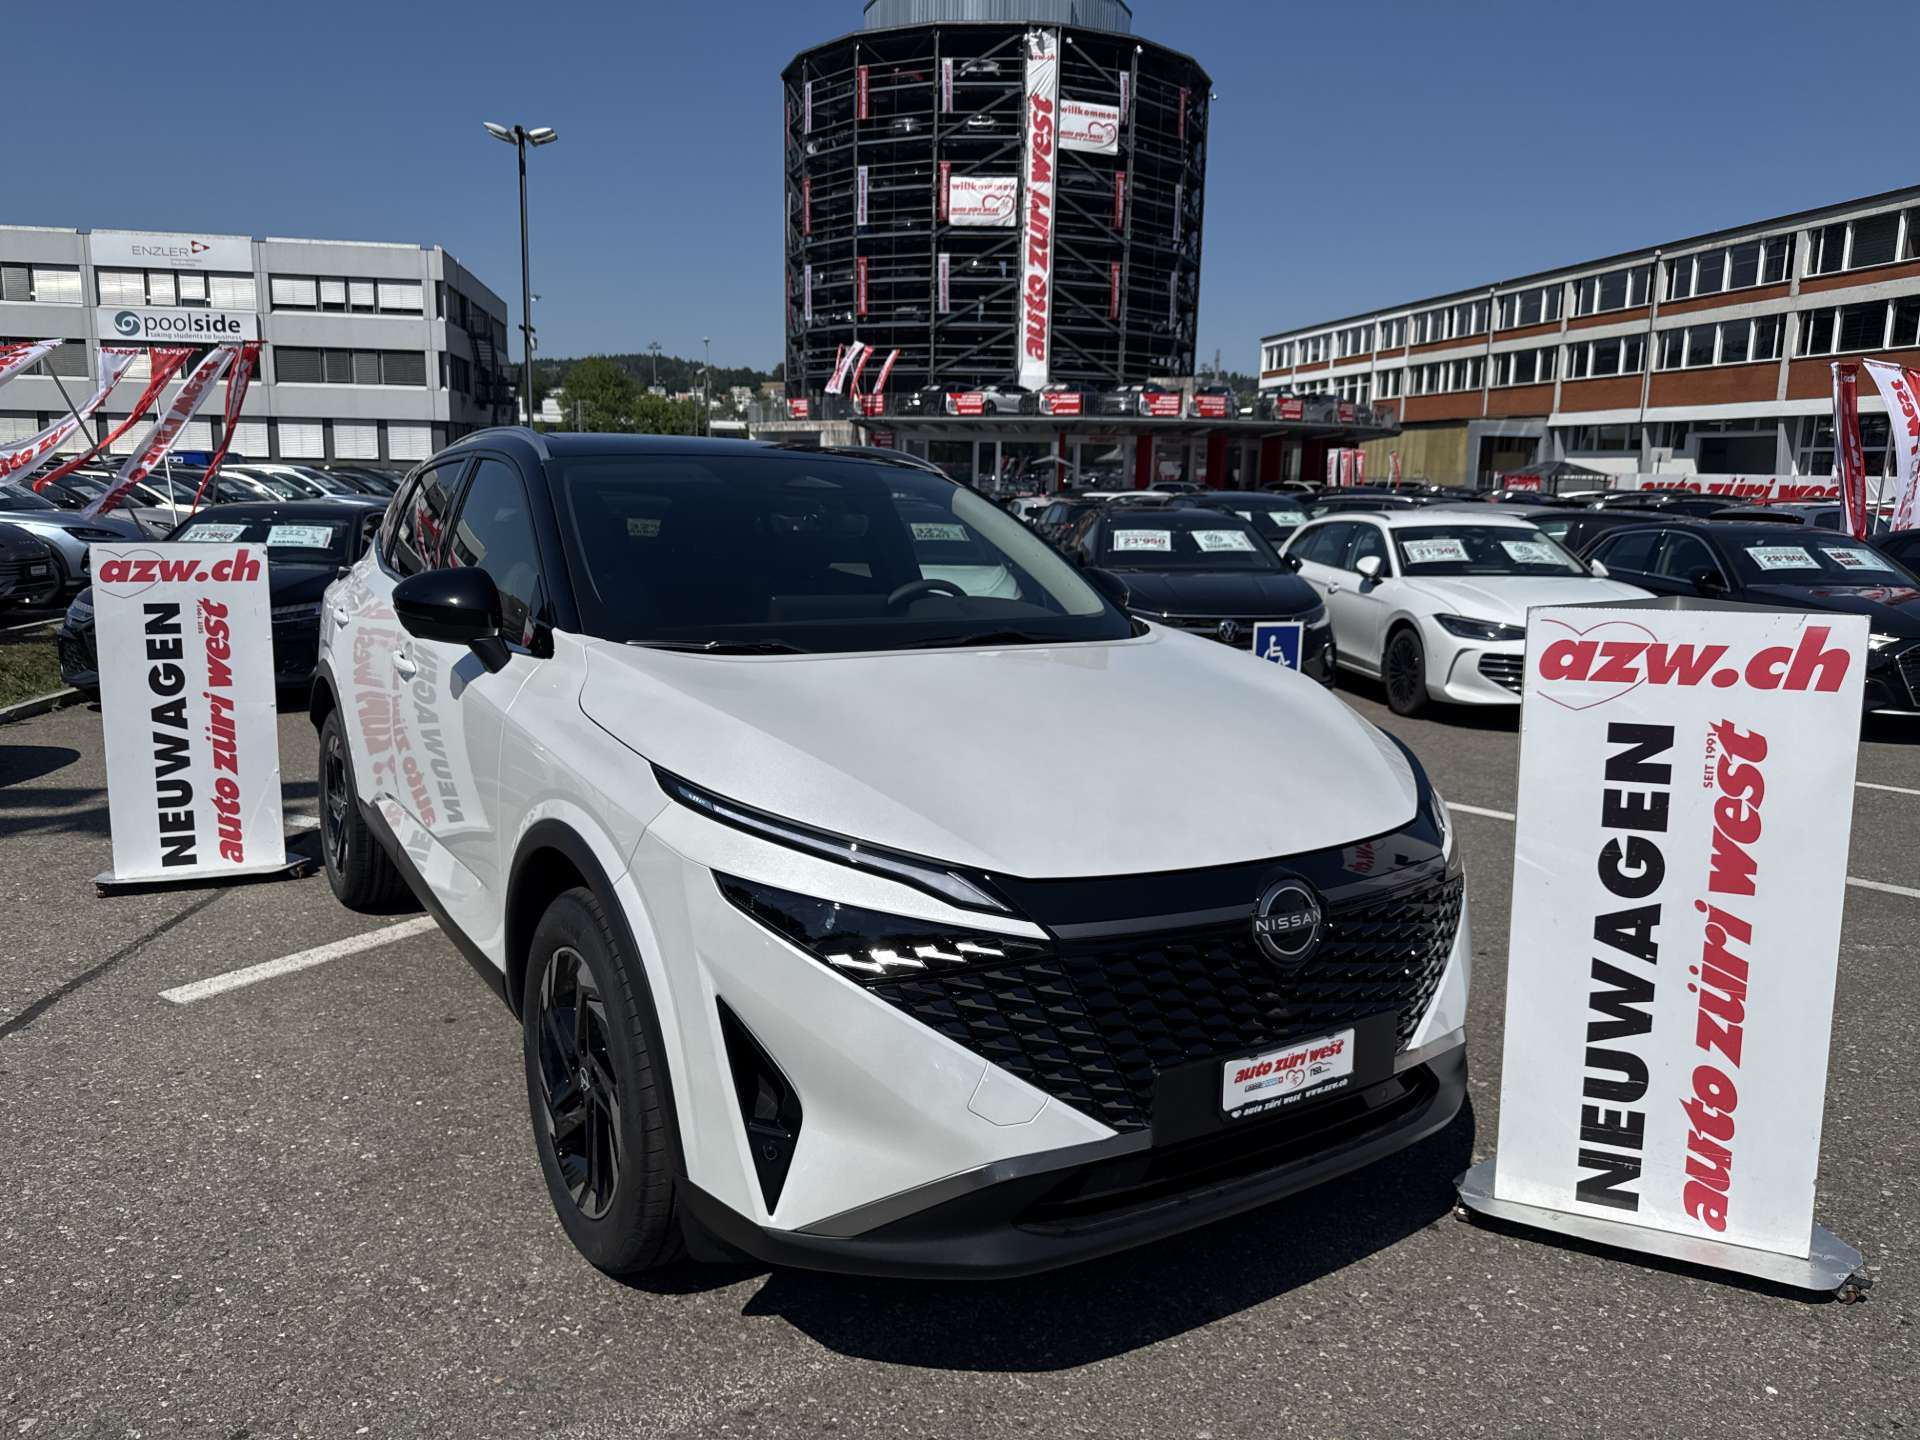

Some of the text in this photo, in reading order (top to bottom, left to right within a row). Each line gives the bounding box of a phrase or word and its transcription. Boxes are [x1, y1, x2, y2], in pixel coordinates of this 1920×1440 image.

[132, 245, 189, 256] ENZLER
[1022, 91, 1054, 361] auto züri west
[144, 313, 241, 337] poolside
[150, 332, 172, 340] taking
[174, 333, 203, 341] students
[100, 550, 261, 582] azw.ch
[1538, 626, 1851, 693] azw.ch
[143, 602, 198, 867] NEUWAGEN
[196, 597, 243, 863] auto züri west
[1703, 732, 1717, 789] SEIT 1991
[1255, 909, 1322, 934] NISSAN
[1576, 722, 1675, 1212] NEUWAGEN
[1680, 718, 1768, 1234] auto züri west
[1234, 1062, 1273, 1084] auto
[1273, 1048, 1310, 1073] züri
[1309, 1038, 1346, 1064] west
